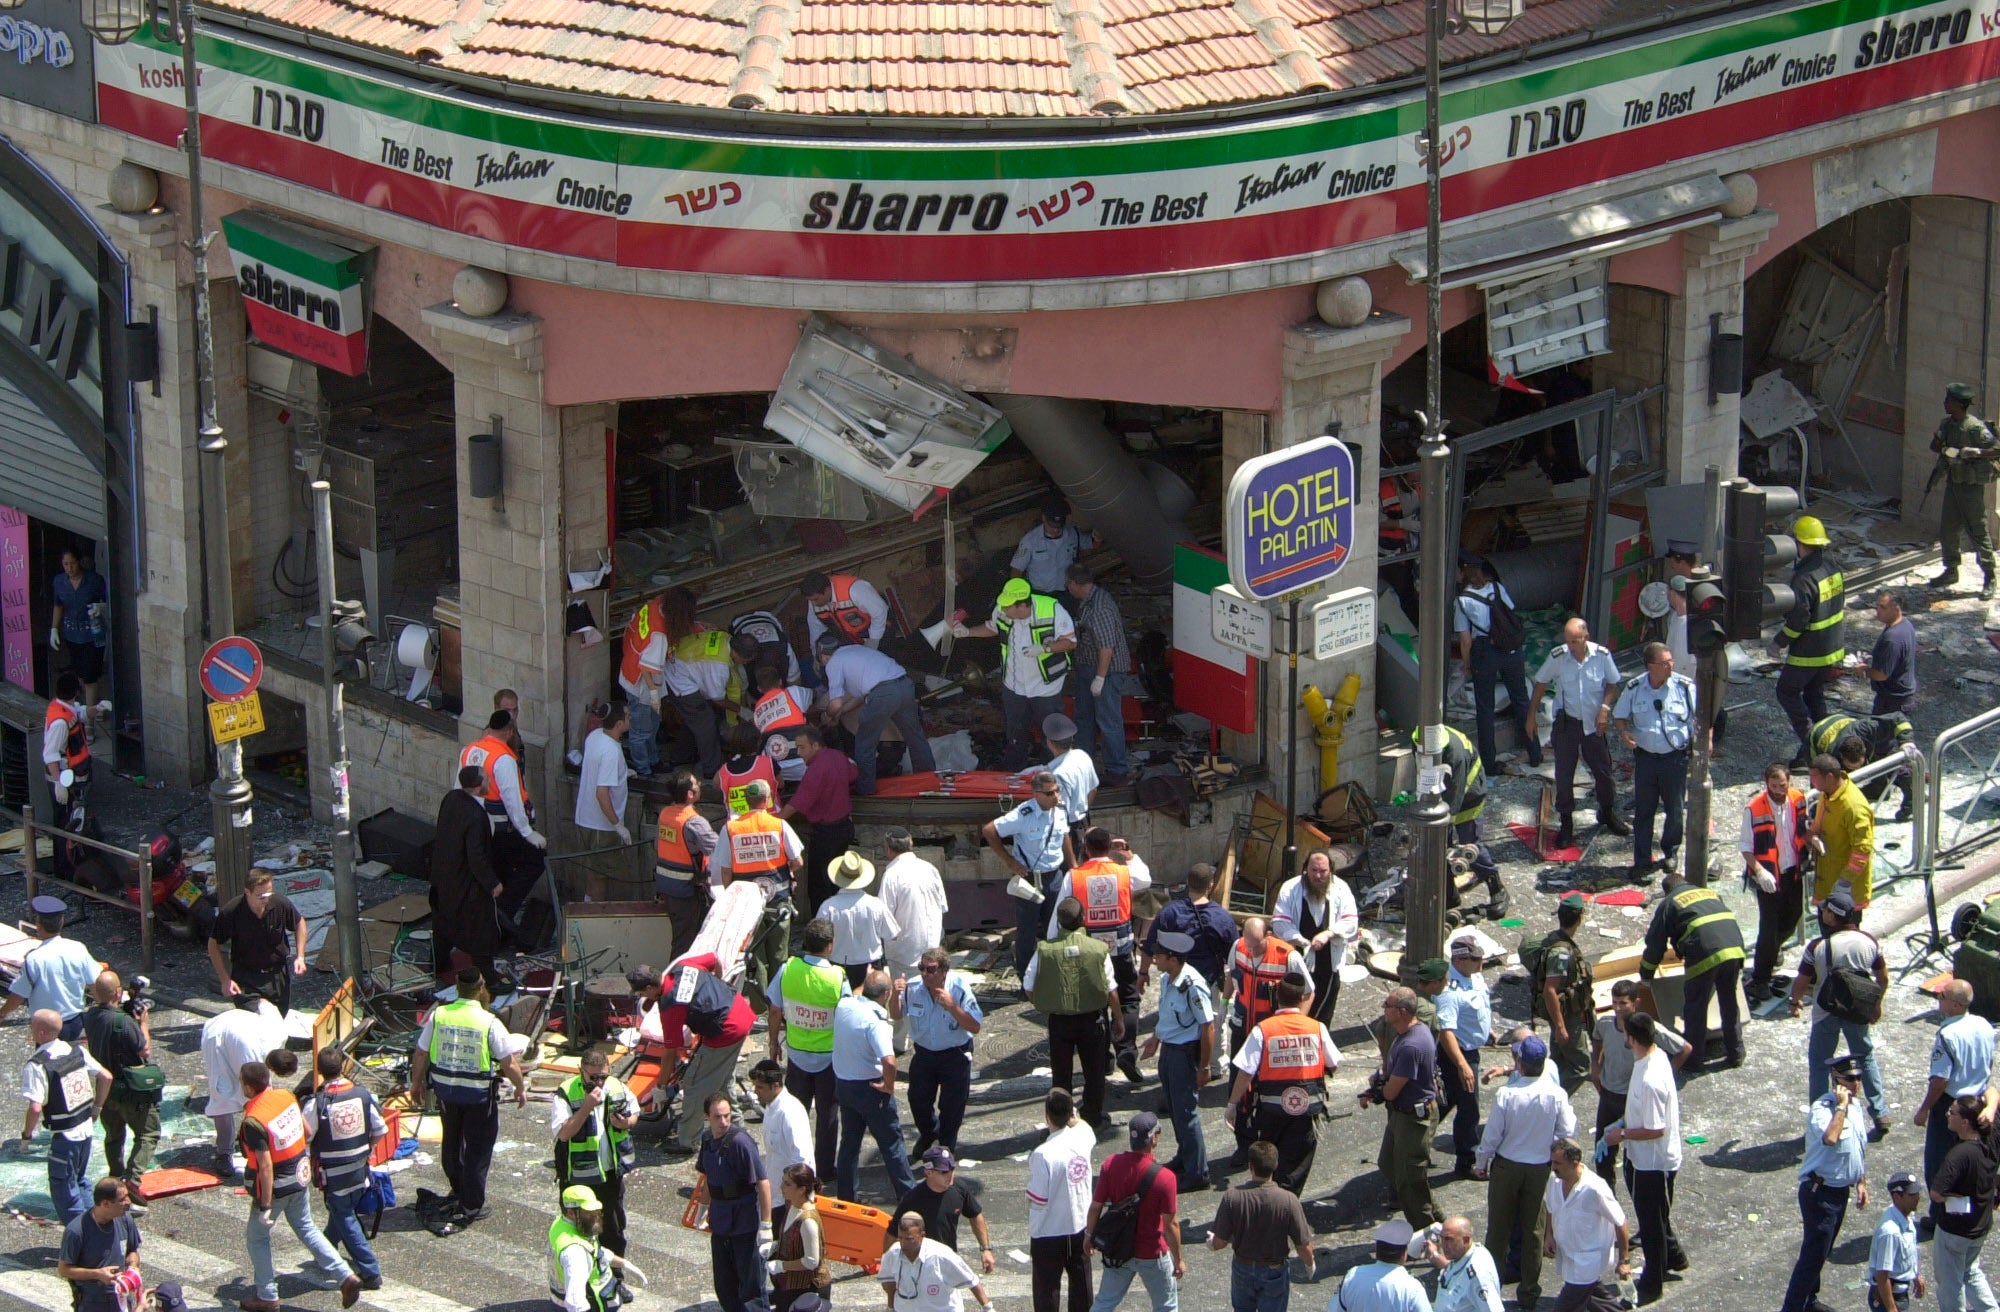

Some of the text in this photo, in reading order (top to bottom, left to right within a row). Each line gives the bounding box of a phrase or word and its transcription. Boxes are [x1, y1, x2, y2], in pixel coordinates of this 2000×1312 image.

[1854, 9, 1971, 69] sbarro
[138, 62, 203, 88] koshr
[1622, 52, 1836, 128] The Best Italian Choice
[252, 85, 325, 142] סברו
[1507, 99, 1587, 157] סברו
[381, 137, 632, 215] The Best Italian Choice
[664, 181, 742, 216] כשר
[1100, 160, 1396, 226] The Best Italian Choice
[802, 183, 1009, 232] sbarro
[1016, 180, 1095, 227] כשר
[240, 262, 341, 331] sbarro
[1248, 466, 1350, 537] HOTEL
[1260, 513, 1337, 565] PALATIN
[1220, 628, 1248, 647] JAFFA
[741, 834, 773, 847] חובש
[1089, 907, 1118, 920] חובש
[1278, 1036, 1311, 1049] חובש
